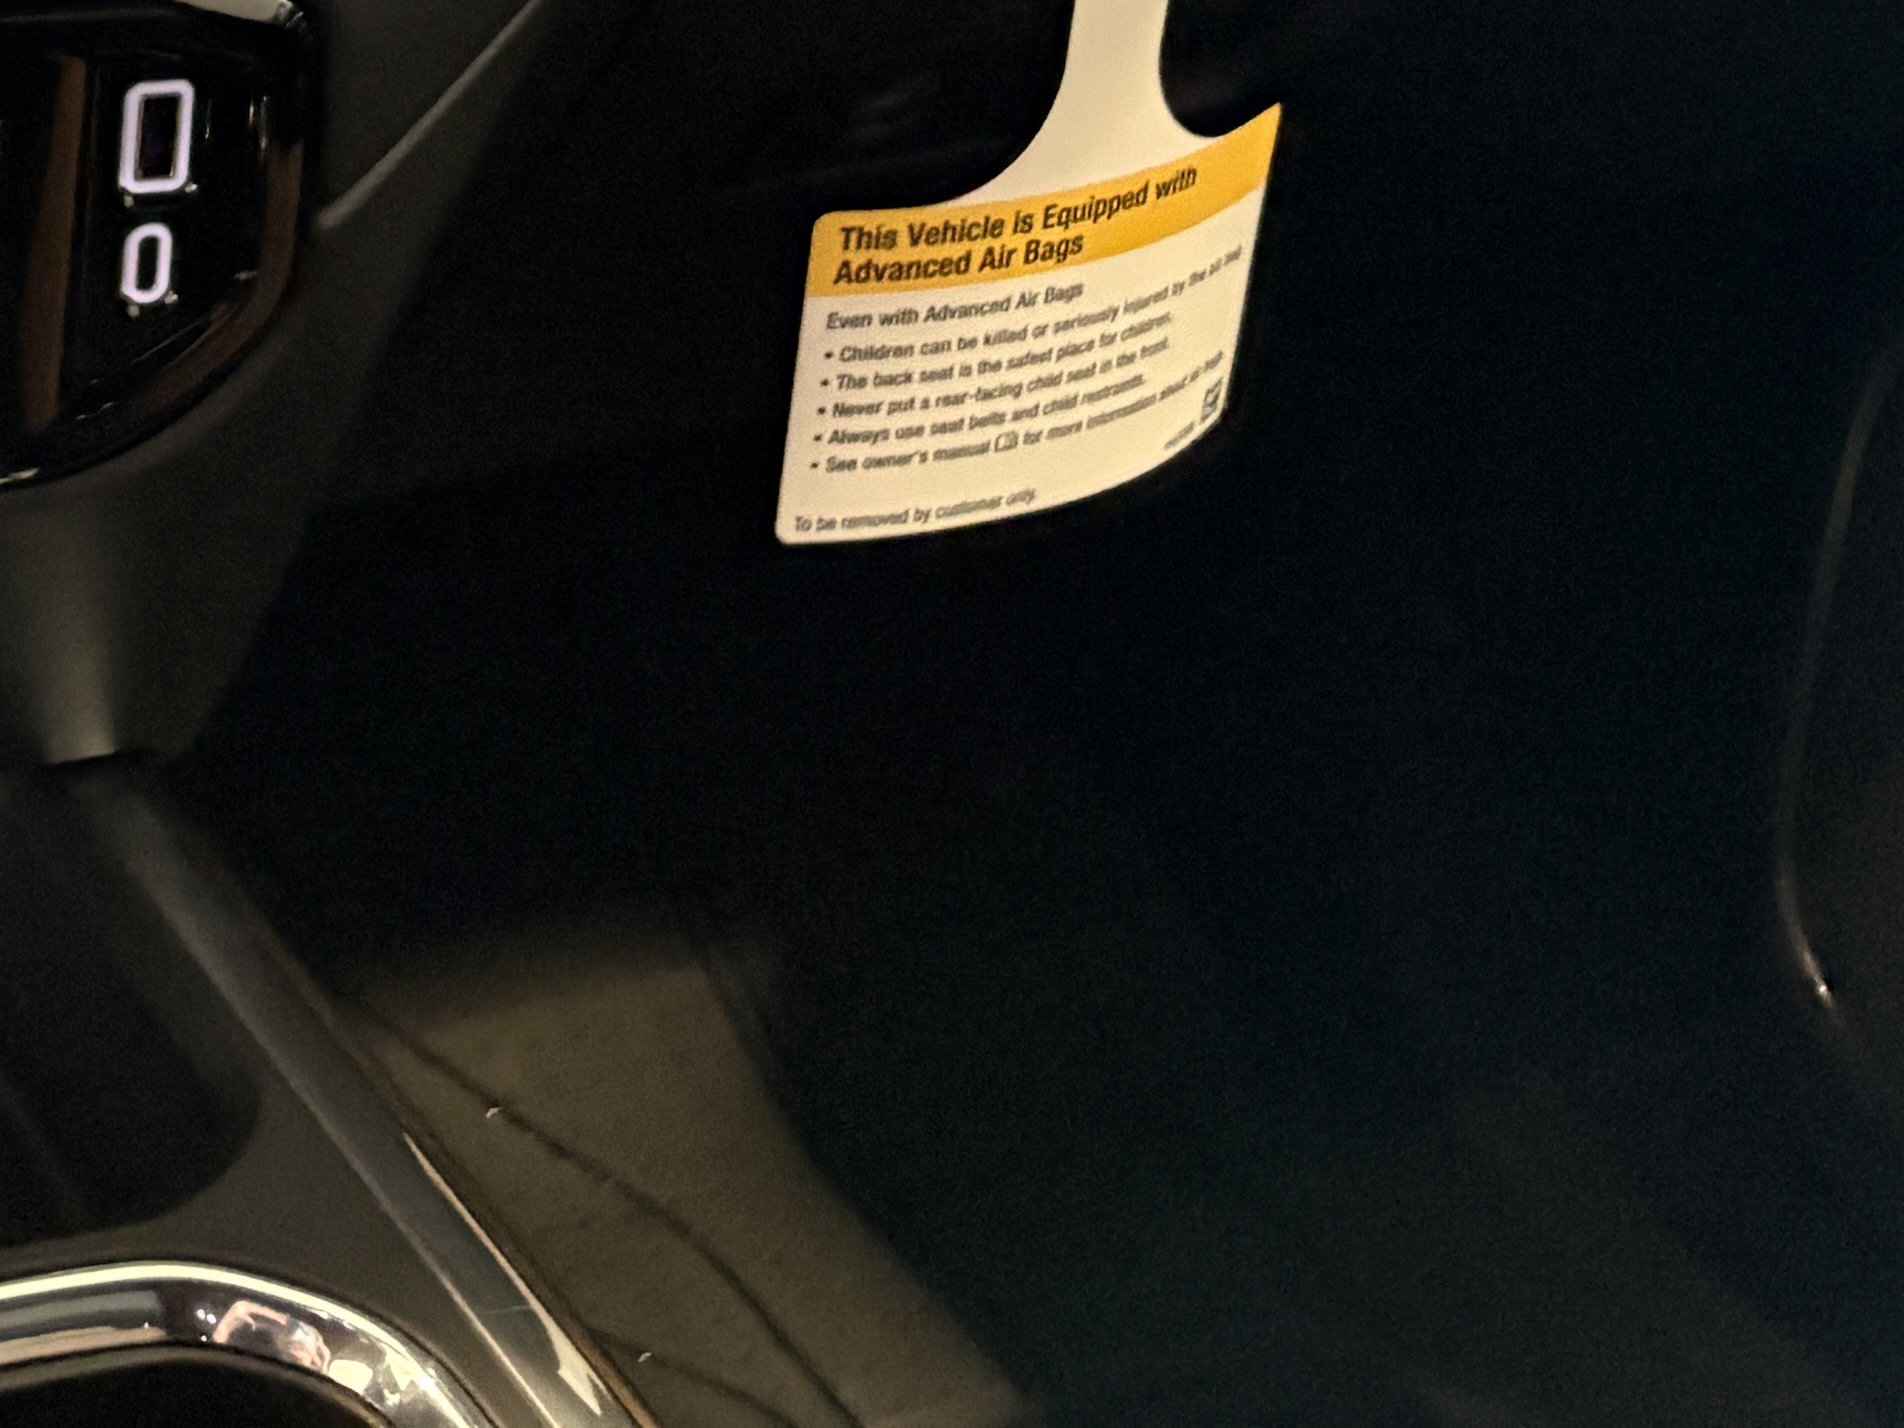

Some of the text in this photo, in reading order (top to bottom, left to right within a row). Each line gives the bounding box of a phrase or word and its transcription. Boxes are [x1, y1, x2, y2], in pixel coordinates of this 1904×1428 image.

[841, 166, 1197, 251] This Vehicle is Equipped with
[833, 235, 1084, 285] Advanced Air Bags
[826, 311, 872, 330] Even
[879, 307, 919, 327] with
[923, 296, 1011, 323] Advanced
[1015, 292, 1040, 310] Air
[839, 344, 915, 362] Children
